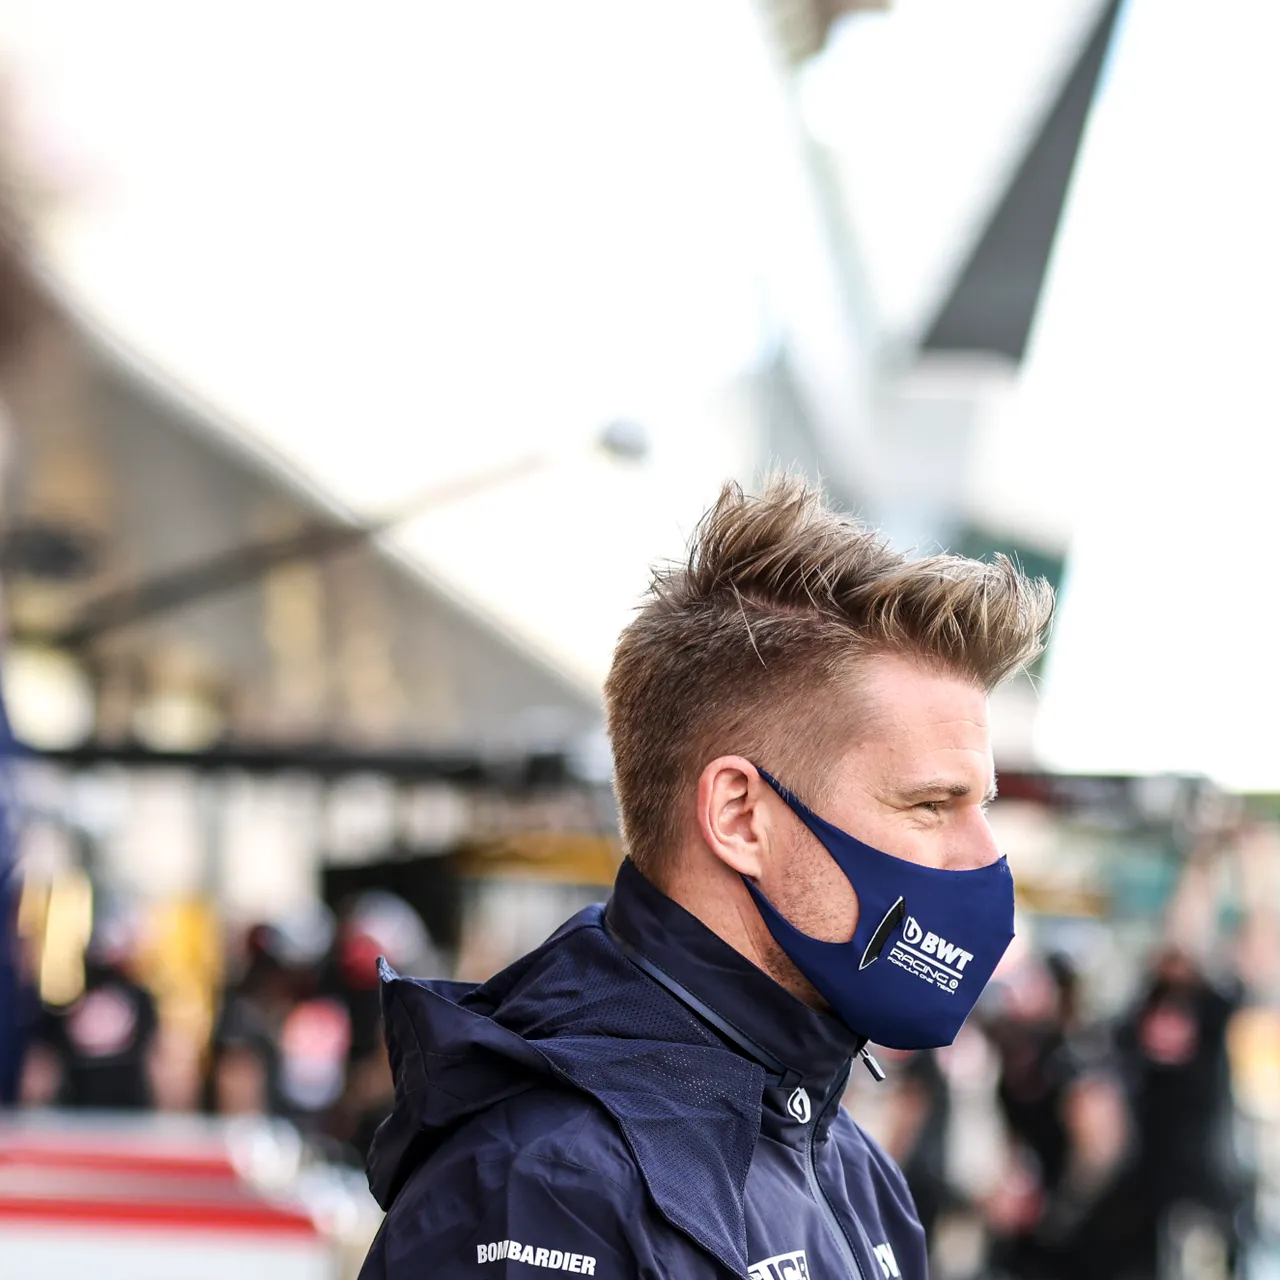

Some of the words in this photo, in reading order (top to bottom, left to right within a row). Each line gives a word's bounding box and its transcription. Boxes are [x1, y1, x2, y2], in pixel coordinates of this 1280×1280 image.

[889, 947, 949, 985] RACING
[920, 931, 974, 971] BWT
[887, 955, 919, 977] FORMULA
[919, 973, 934, 984] ONE
[936, 981, 955, 995] TEAM
[476, 1239, 597, 1276] BOMBARDIER
